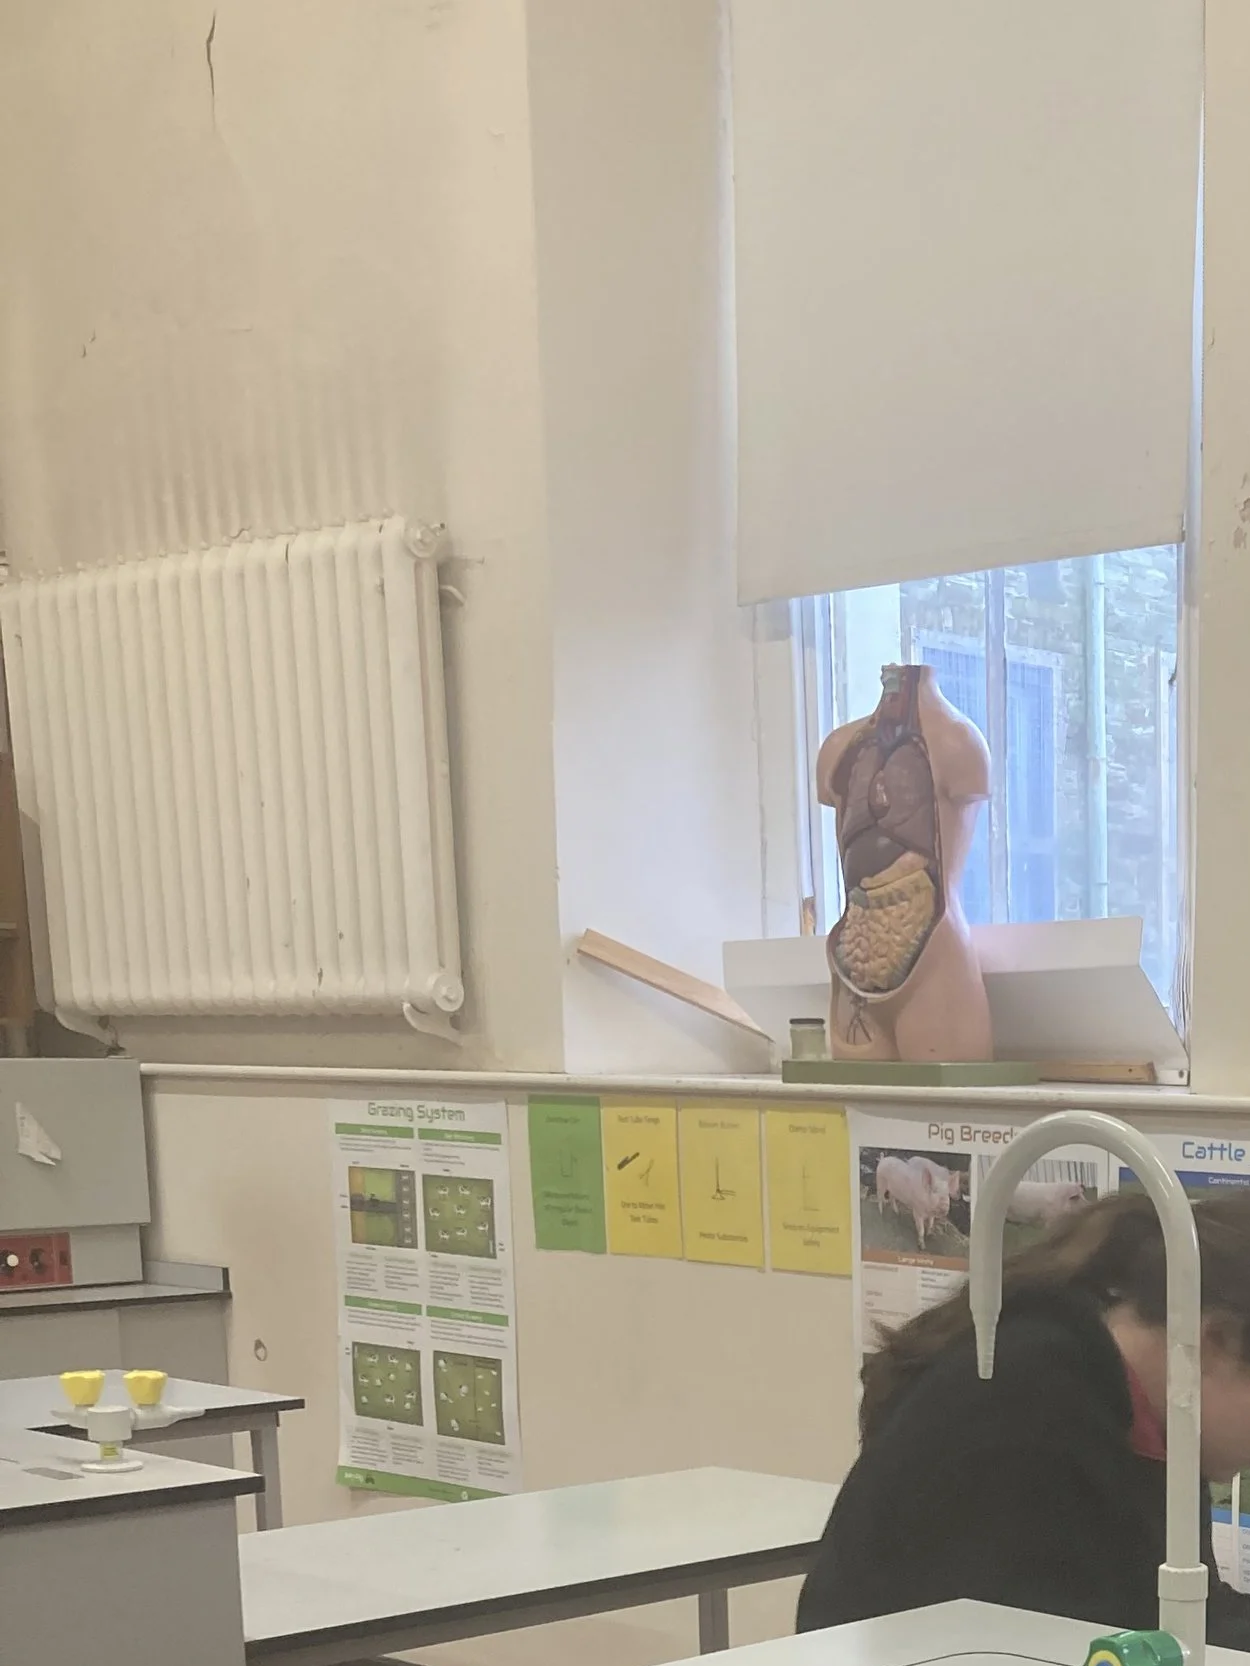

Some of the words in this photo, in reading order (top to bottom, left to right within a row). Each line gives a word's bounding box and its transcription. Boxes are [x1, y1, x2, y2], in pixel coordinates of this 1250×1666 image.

[367, 1102, 414, 1122] Grazing
[416, 1104, 466, 1124] System
[928, 1123, 955, 1145] Pig
[960, 1125, 1018, 1144] Breed
[1182, 1141, 1246, 1162] Cattle
